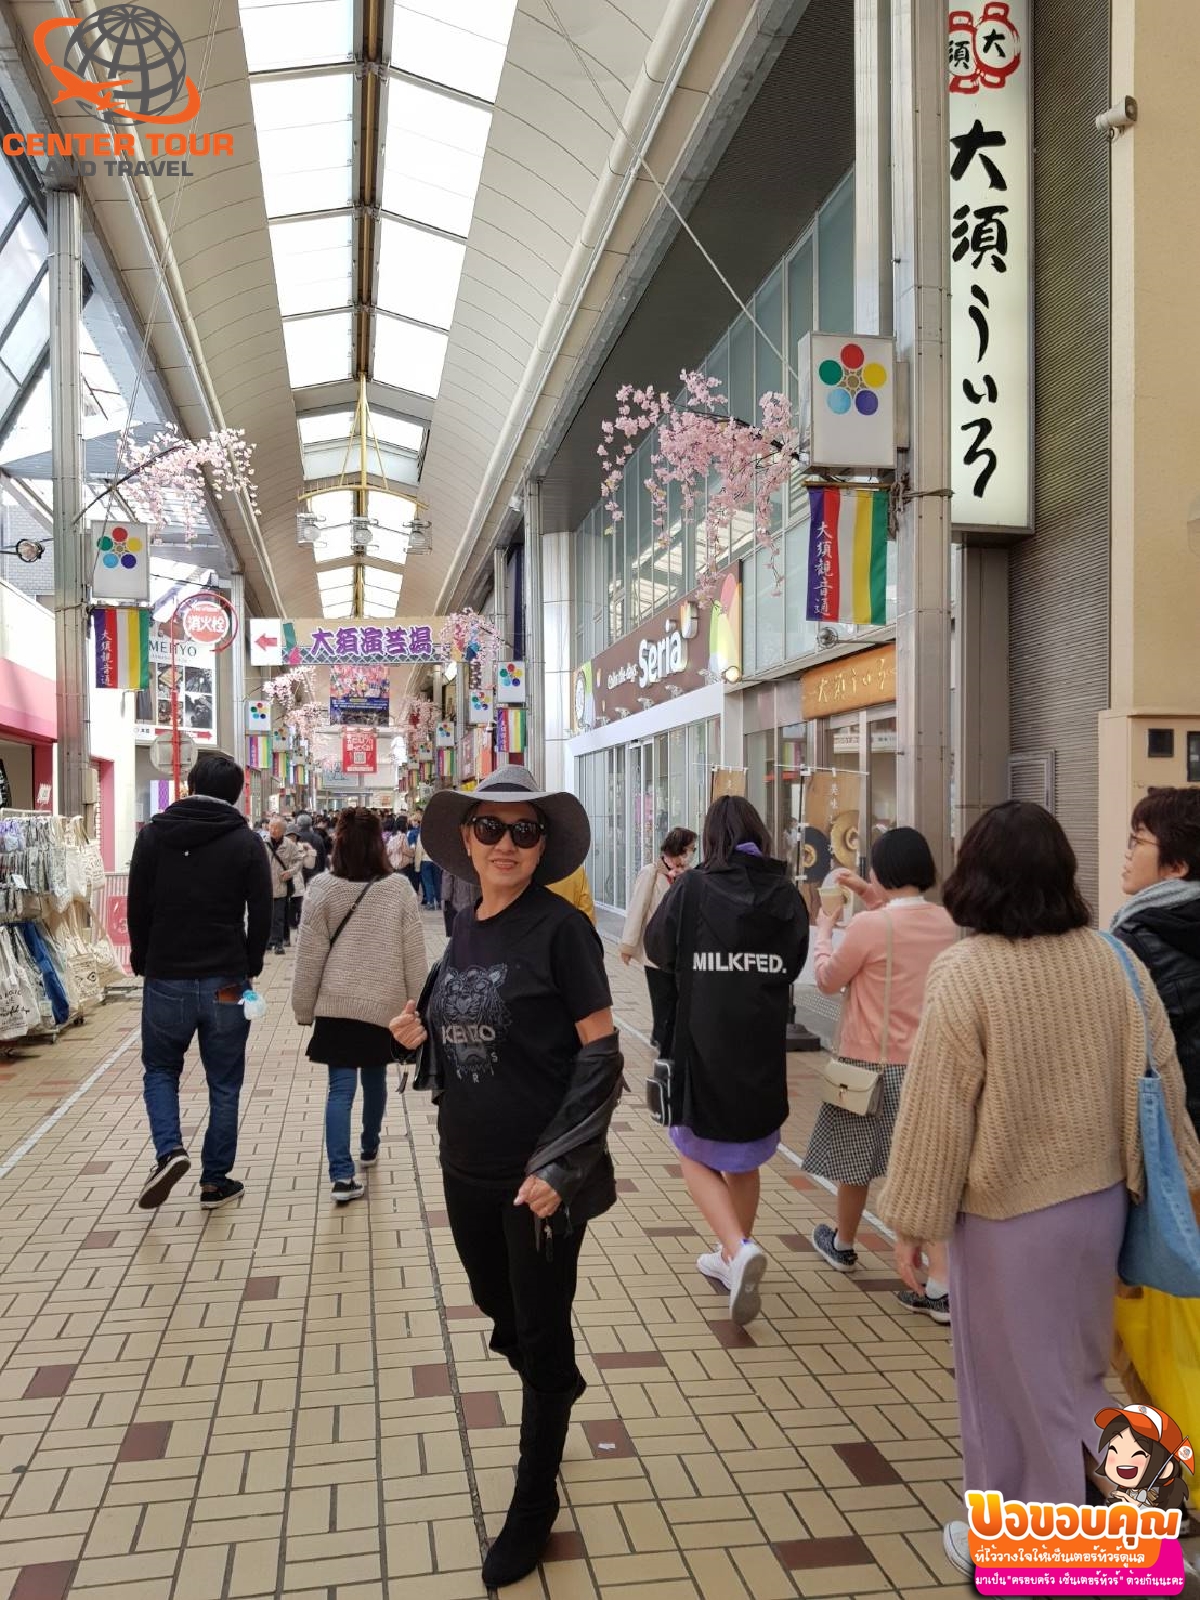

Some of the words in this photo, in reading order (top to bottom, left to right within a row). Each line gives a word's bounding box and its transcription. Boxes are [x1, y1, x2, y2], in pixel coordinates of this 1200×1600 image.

[948, 40, 970, 70] 須
[982, 28, 1006, 58] 大
[950, 119, 1009, 499] 大須ういろ
[187, 614, 226, 635] 消火栓
[310, 625, 434, 656] 大須演芸場
[638, 618, 687, 689] Seria
[692, 952, 787, 974] MILKFED.
